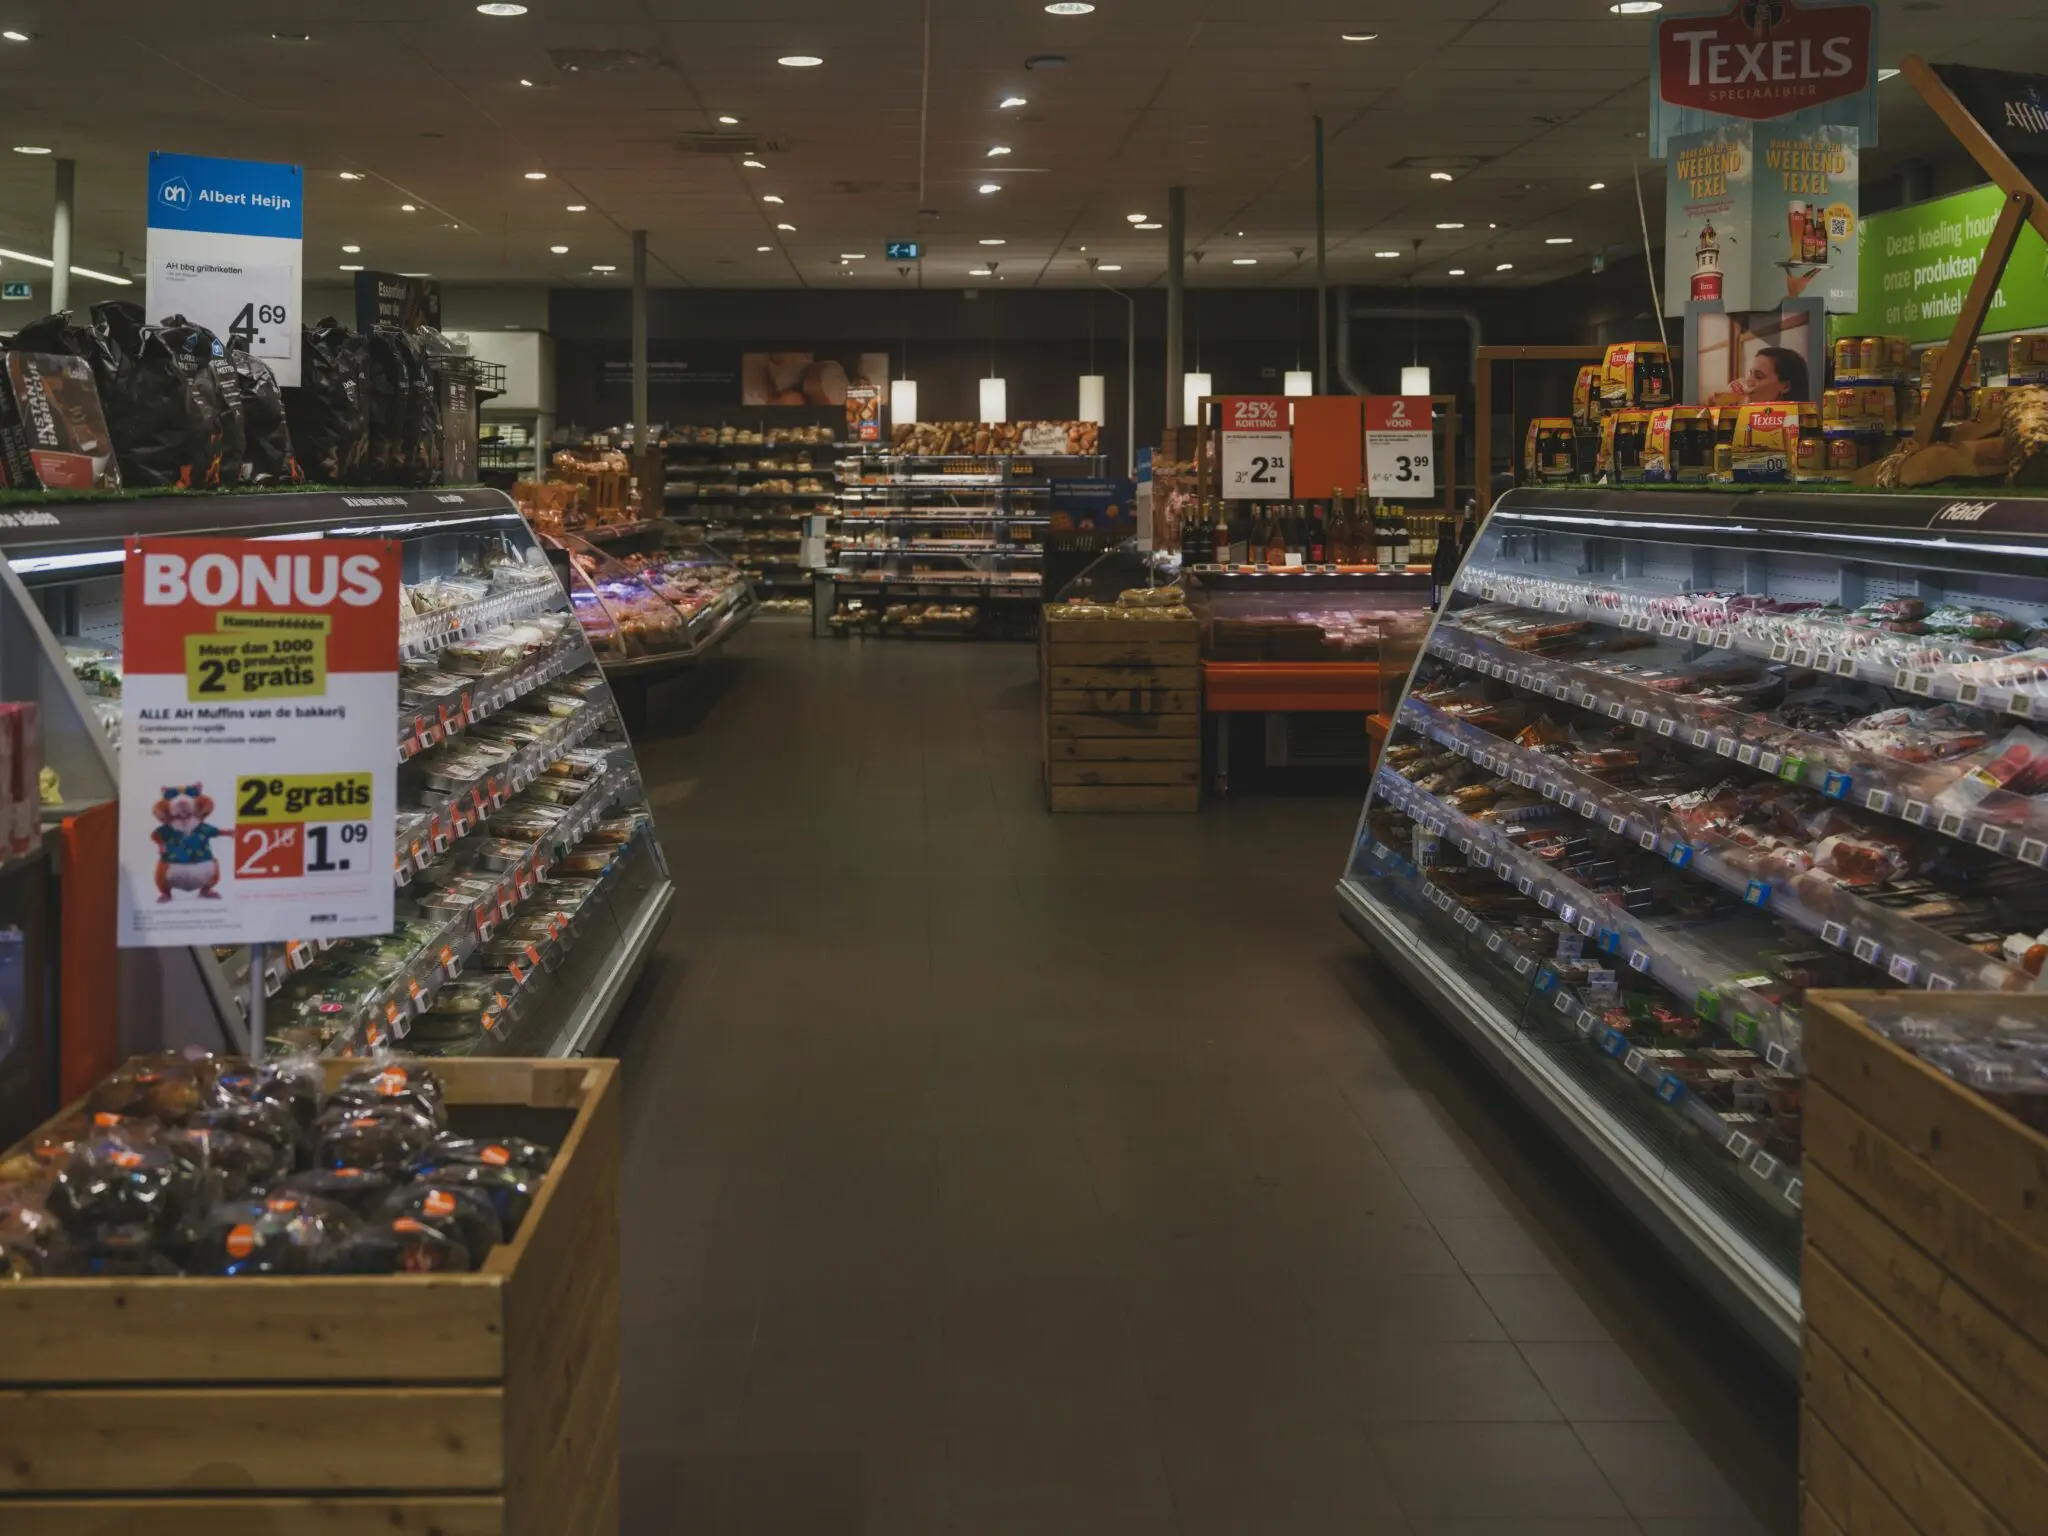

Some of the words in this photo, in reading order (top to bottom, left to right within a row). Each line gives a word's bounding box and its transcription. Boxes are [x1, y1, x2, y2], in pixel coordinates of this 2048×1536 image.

[1673, 30, 1853, 86] TEXELS
[1709, 85, 1818, 101] SPECIAALBIER
[1676, 153, 1742, 180] WEEKEND
[1766, 148, 1845, 174] WEEKEND
[1689, 175, 1727, 199] TEXEL
[1783, 172, 1828, 195] TEXEL
[198, 189, 247, 206] Albert
[251, 192, 291, 211] Heijn
[1887, 233, 1916, 257] Deze
[1919, 220, 1962, 250] koeling
[1966, 207, 2003, 240] houd
[165, 261, 179, 269] AH
[180, 263, 195, 273] bbq
[1884, 268, 1912, 292] onze
[1914, 255, 1977, 291] produkten
[1886, 306, 1901, 324] en
[1904, 298, 1918, 323] de
[1921, 288, 1963, 319] winkel
[228, 302, 287, 344] 4.69
[24, 374, 50, 444] INSTANT
[1235, 401, 1278, 419] 25%
[1392, 401, 1406, 418] 2
[1751, 414, 1785, 426] TEXELS
[1235, 419, 1277, 428] KORTING
[1385, 418, 1412, 428] VOOR
[1251, 456, 1284, 483] 2.31
[1395, 455, 1429, 482] 3.99
[1939, 500, 1998, 521] Halal
[143, 553, 383, 607] BONUS
[199, 643, 238, 657] Meer
[241, 641, 268, 654] dan
[273, 639, 313, 653] 1000
[243, 653, 314, 668] producten
[199, 657, 241, 693] 2e
[242, 664, 315, 692] gratis
[139, 707, 170, 719] ALLE
[174, 707, 193, 719] AH
[197, 706, 246, 719] Muffins
[249, 708, 272, 719] van
[275, 706, 292, 718] de
[295, 704, 346, 720] bakkerij
[239, 779, 284, 817] 2e
[285, 778, 371, 813] gratis
[306, 823, 369, 872] 1.09
